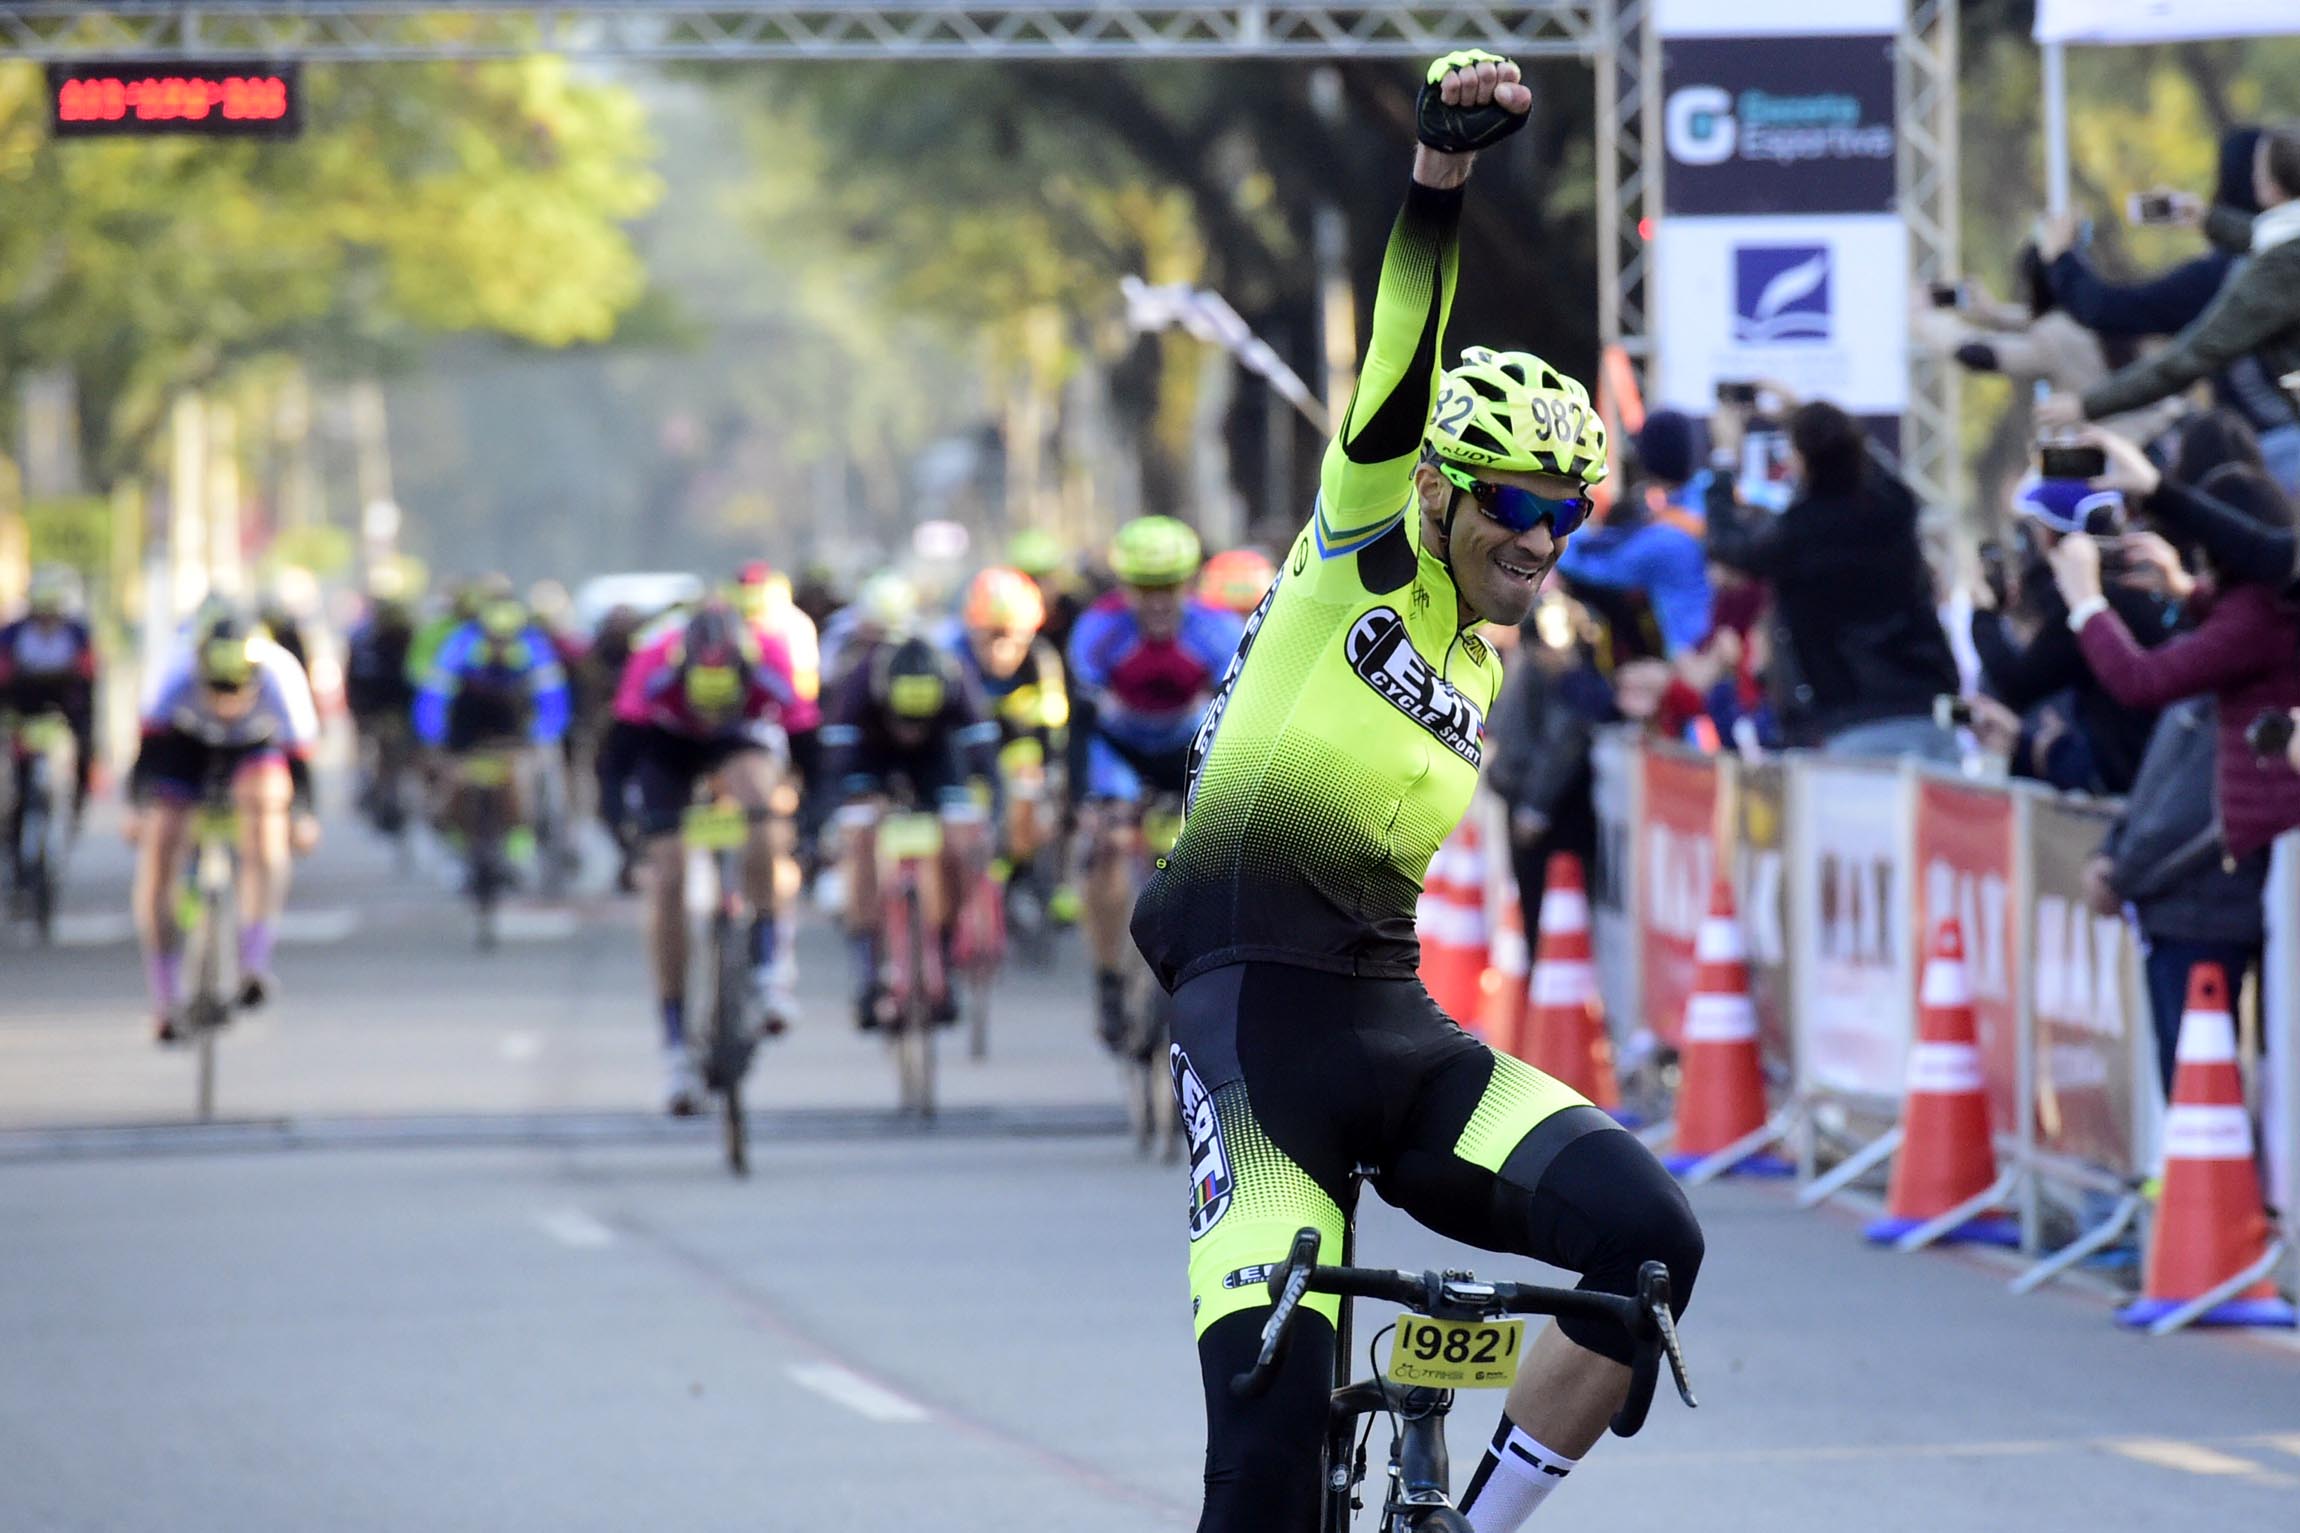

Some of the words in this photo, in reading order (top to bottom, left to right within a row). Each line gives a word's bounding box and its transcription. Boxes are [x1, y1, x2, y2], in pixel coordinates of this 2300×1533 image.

[1531, 397, 1587, 447] 982
[1370, 671, 1441, 725] CYCLE
[1439, 725, 1481, 763] SPORT
[1414, 1325, 1500, 1364] 982
